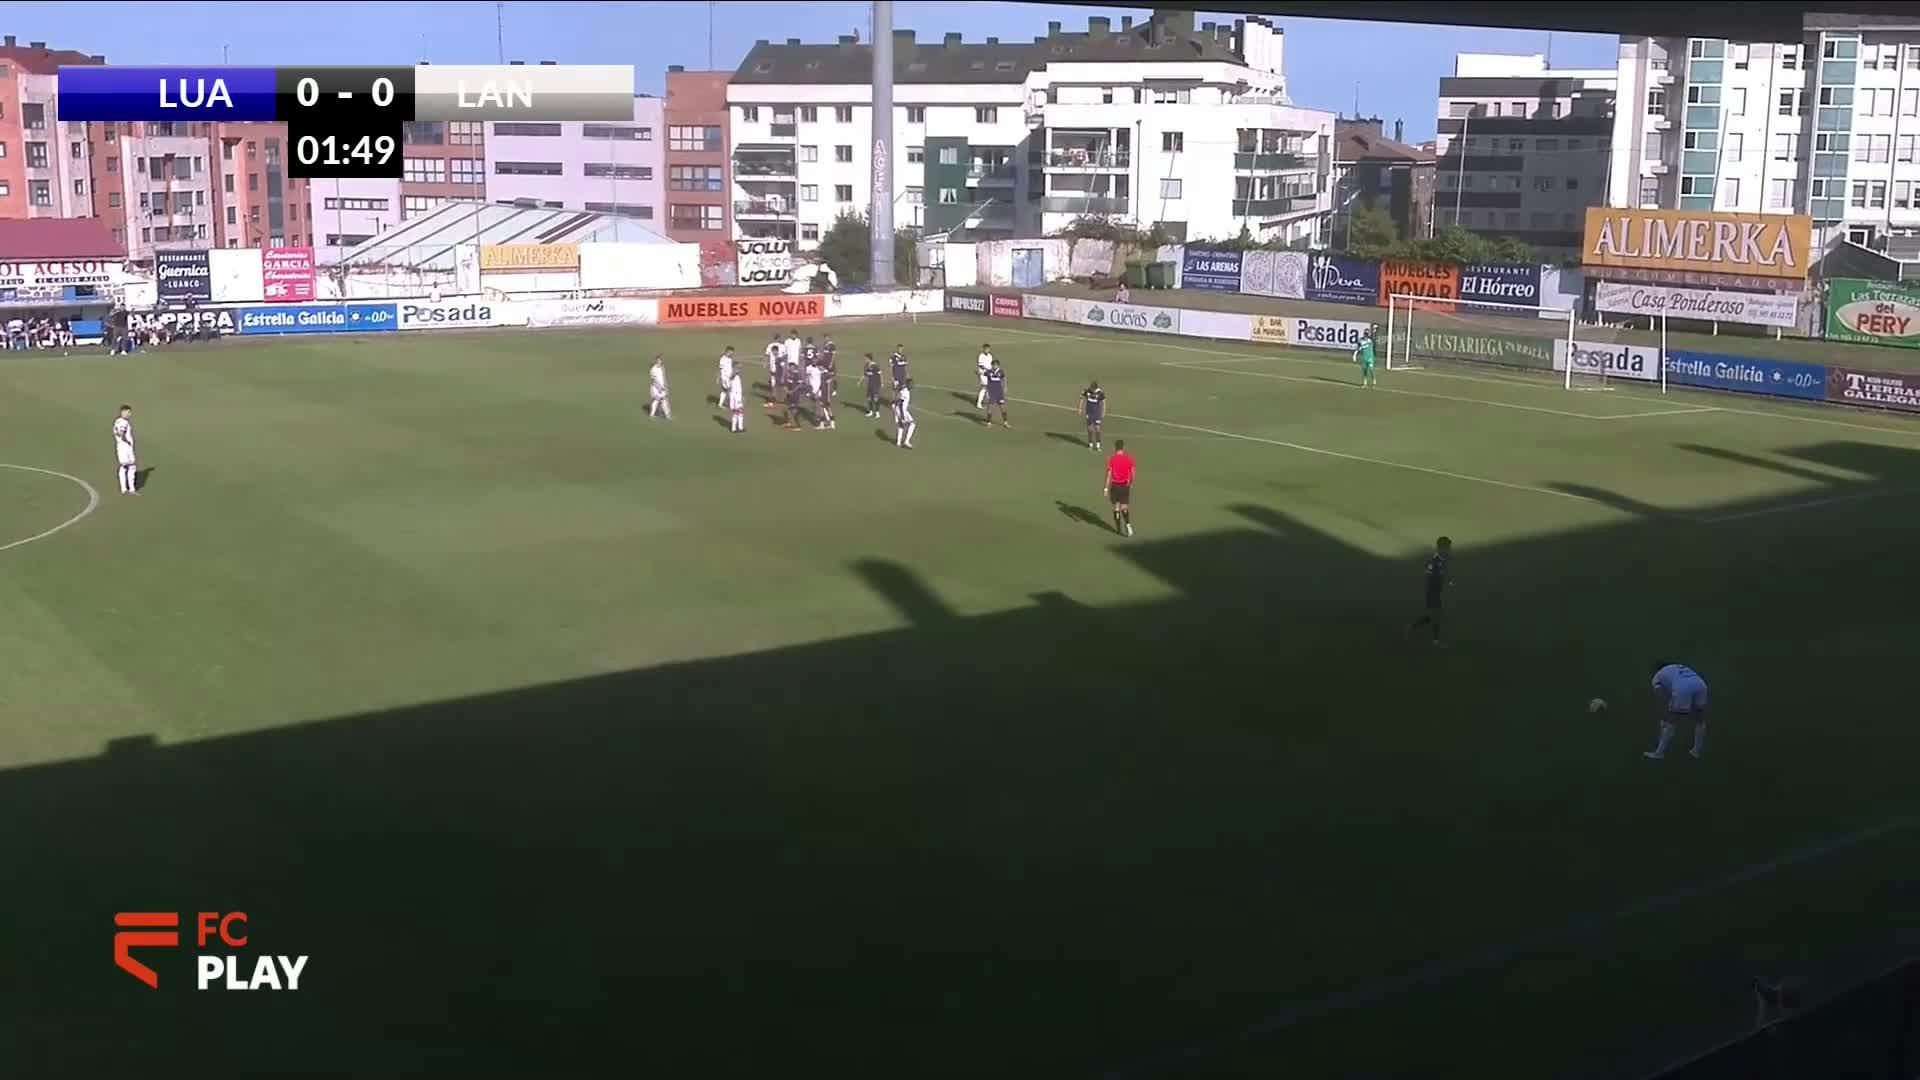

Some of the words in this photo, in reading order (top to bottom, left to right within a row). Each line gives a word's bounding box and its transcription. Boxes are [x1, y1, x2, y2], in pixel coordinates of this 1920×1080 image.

[1593, 216, 1796, 268] ALIMERKA
[485, 246, 574, 266] ALIMERKA
[34, 260, 110, 276] ACESOL
[159, 263, 210, 280] Guernica
[1196, 260, 1209, 271] LAS
[1211, 261, 1240, 273] ARENAS
[1384, 260, 1450, 279] MUEBLES
[1384, 279, 1451, 305] NOVAR
[1461, 276, 1477, 293] El
[1481, 277, 1535, 298] Hórreo
[1851, 291, 1870, 301] Las
[667, 302, 748, 318] MUEBLES
[759, 301, 817, 316] NOVAR
[1631, 289, 1665, 310] Casa
[1669, 293, 1745, 316] Ponderoso
[1875, 302, 1894, 314] del
[243, 311, 294, 326] Estrella
[298, 311, 345, 325] Galicia
[403, 304, 491, 323] Posada
[1298, 320, 1359, 345] Posada
[1857, 313, 1911, 334] PERY
[807, 349, 814, 359] 5
[1664, 357, 1711, 377] Estrella
[1715, 362, 1764, 383] Galicia
